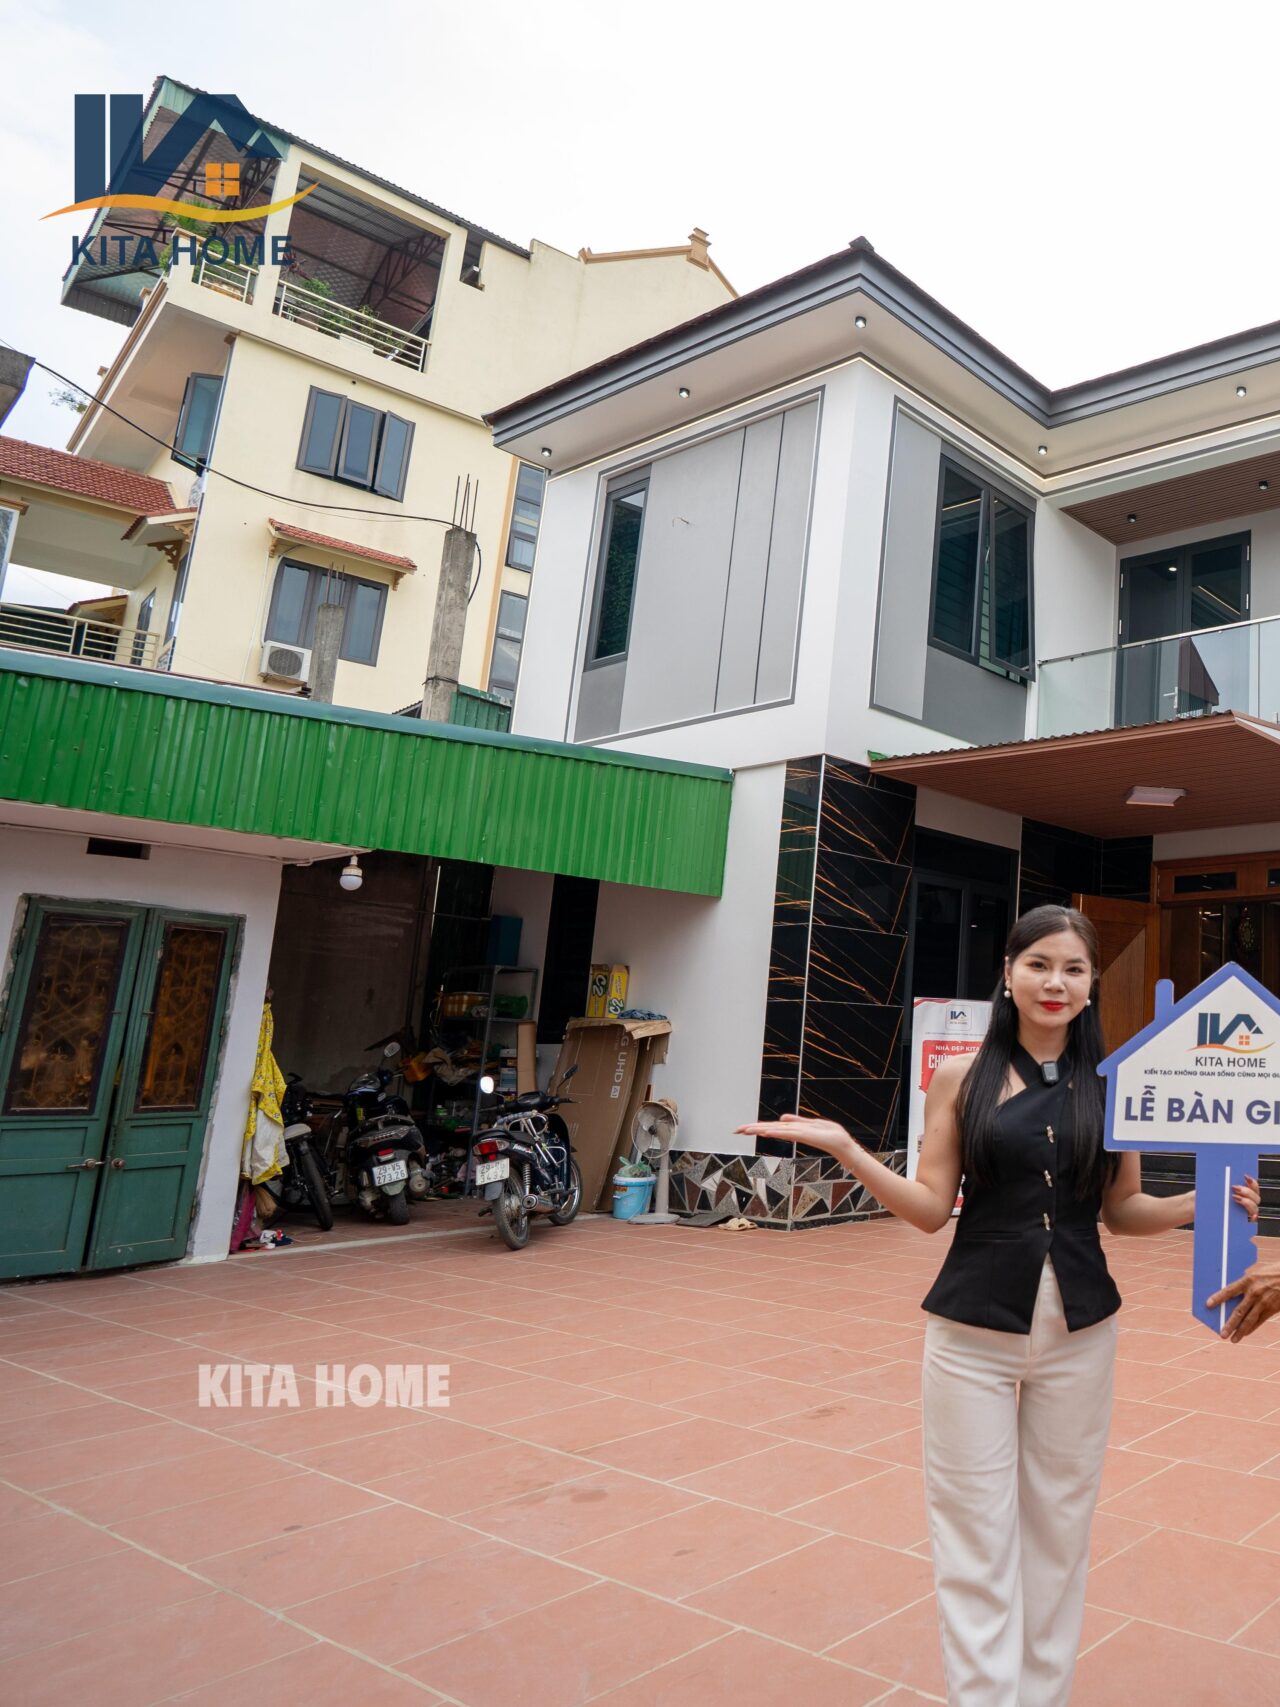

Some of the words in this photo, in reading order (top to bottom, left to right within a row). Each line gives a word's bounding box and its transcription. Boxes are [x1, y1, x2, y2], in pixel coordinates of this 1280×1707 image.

[593, 974, 607, 997] C2
[609, 998, 624, 1015] C2
[614, 1051, 628, 1083] UHD
[1195, 1056, 1224, 1067] KITA
[1227, 1057, 1267, 1068] HOME
[1217, 1070, 1236, 1078] SỐNG
[1124, 1085, 1157, 1122] LỄ
[1167, 1091, 1234, 1124] BÀN
